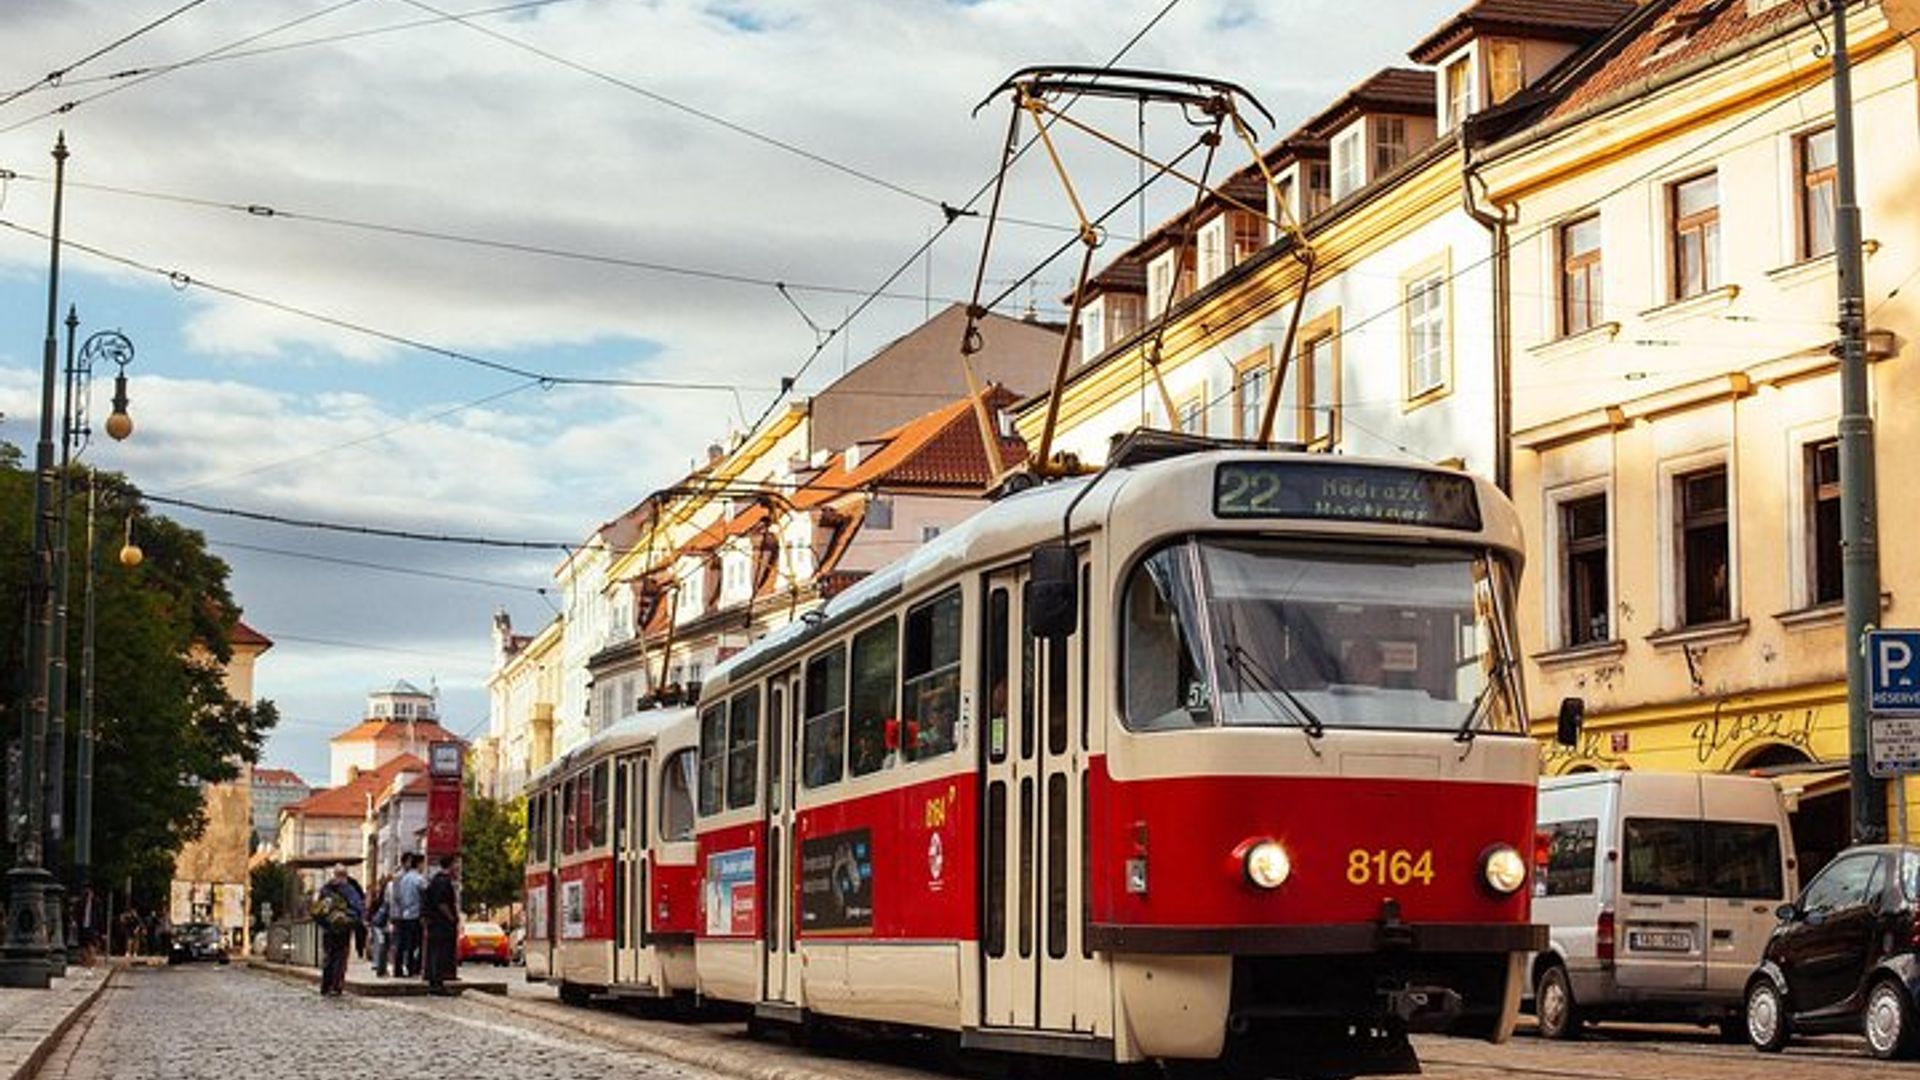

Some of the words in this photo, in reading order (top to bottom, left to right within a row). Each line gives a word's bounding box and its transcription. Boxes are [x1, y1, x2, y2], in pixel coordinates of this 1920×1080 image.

[1219, 469, 1281, 512] 22
[1880, 641, 1912, 687] P
[1347, 849, 1435, 885] 8164
